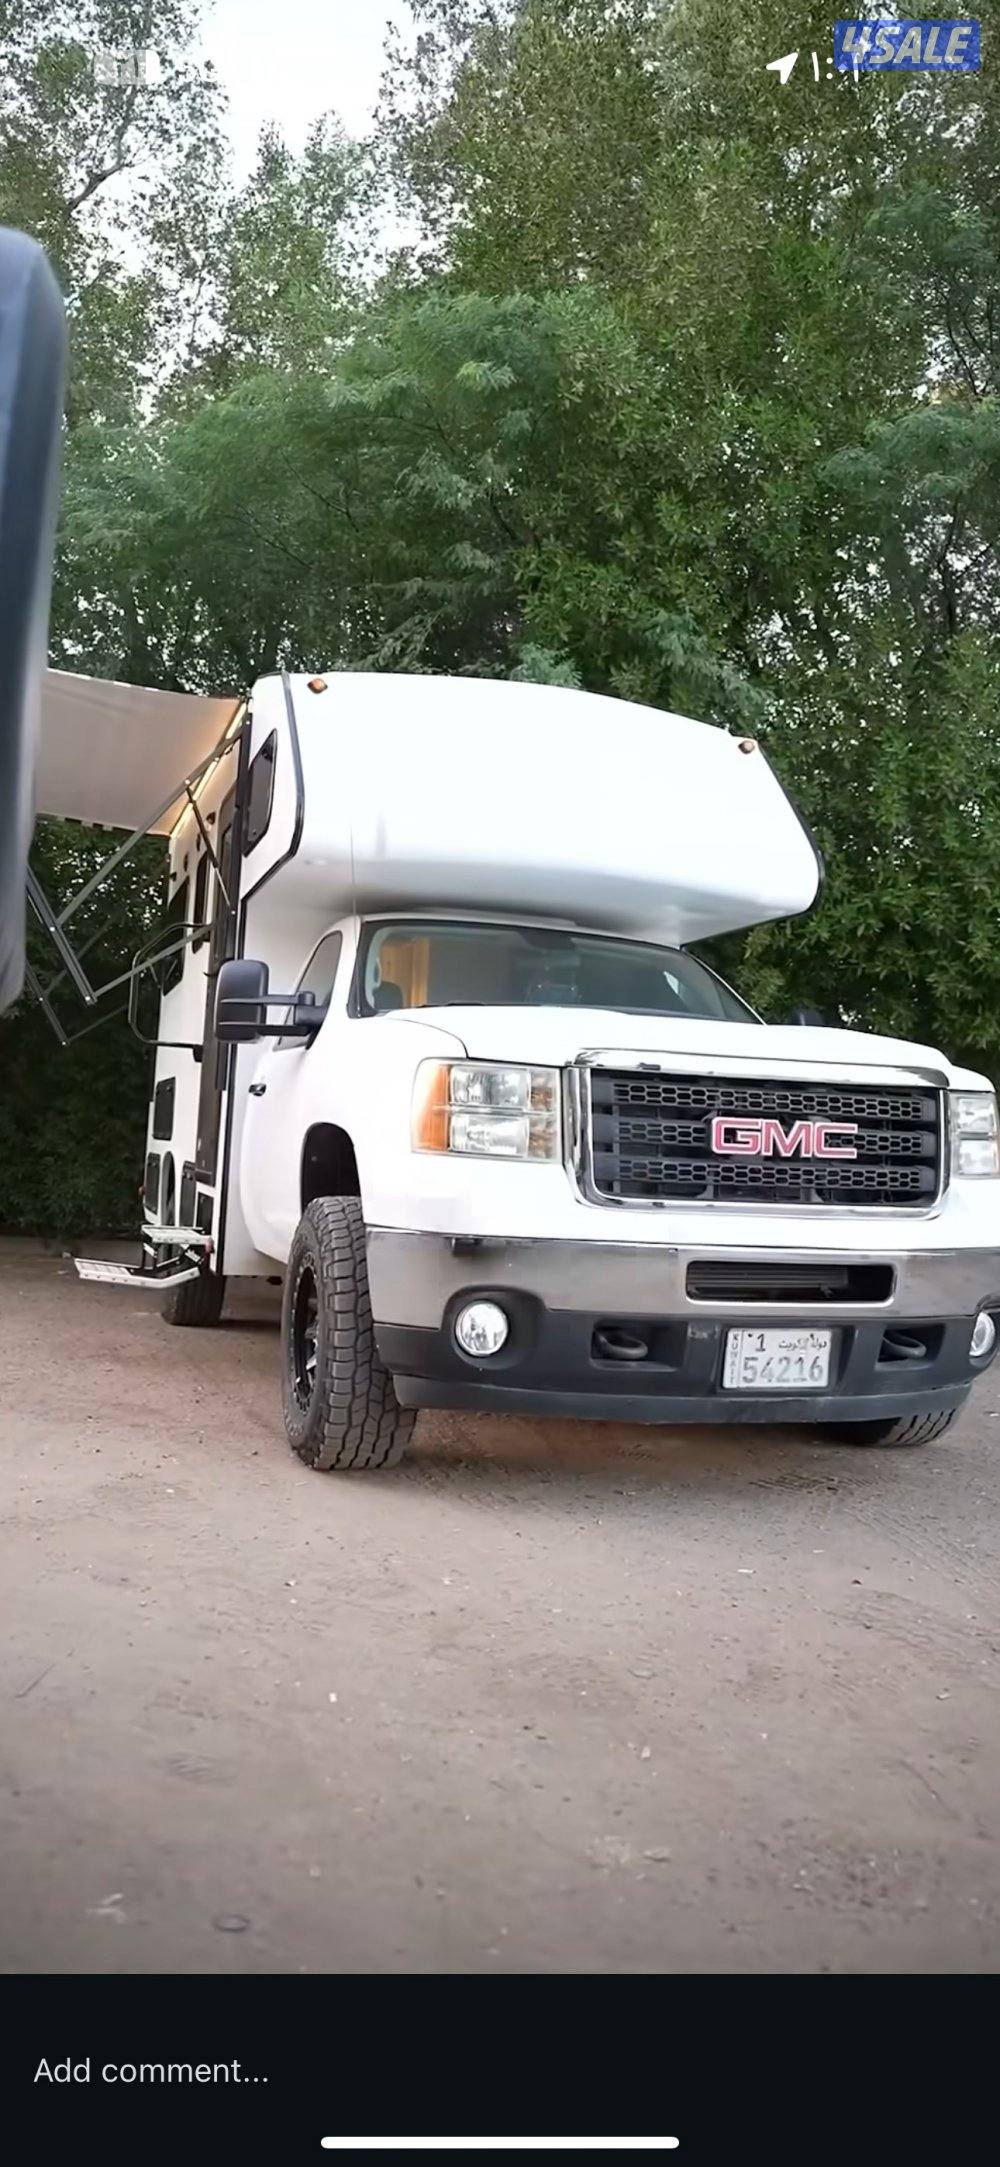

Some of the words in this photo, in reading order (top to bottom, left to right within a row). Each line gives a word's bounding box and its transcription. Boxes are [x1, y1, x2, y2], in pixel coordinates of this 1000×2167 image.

[712, 1117, 859, 1159] GMC
[755, 1333, 766, 1352] 1
[742, 1356, 824, 1383] 54216
